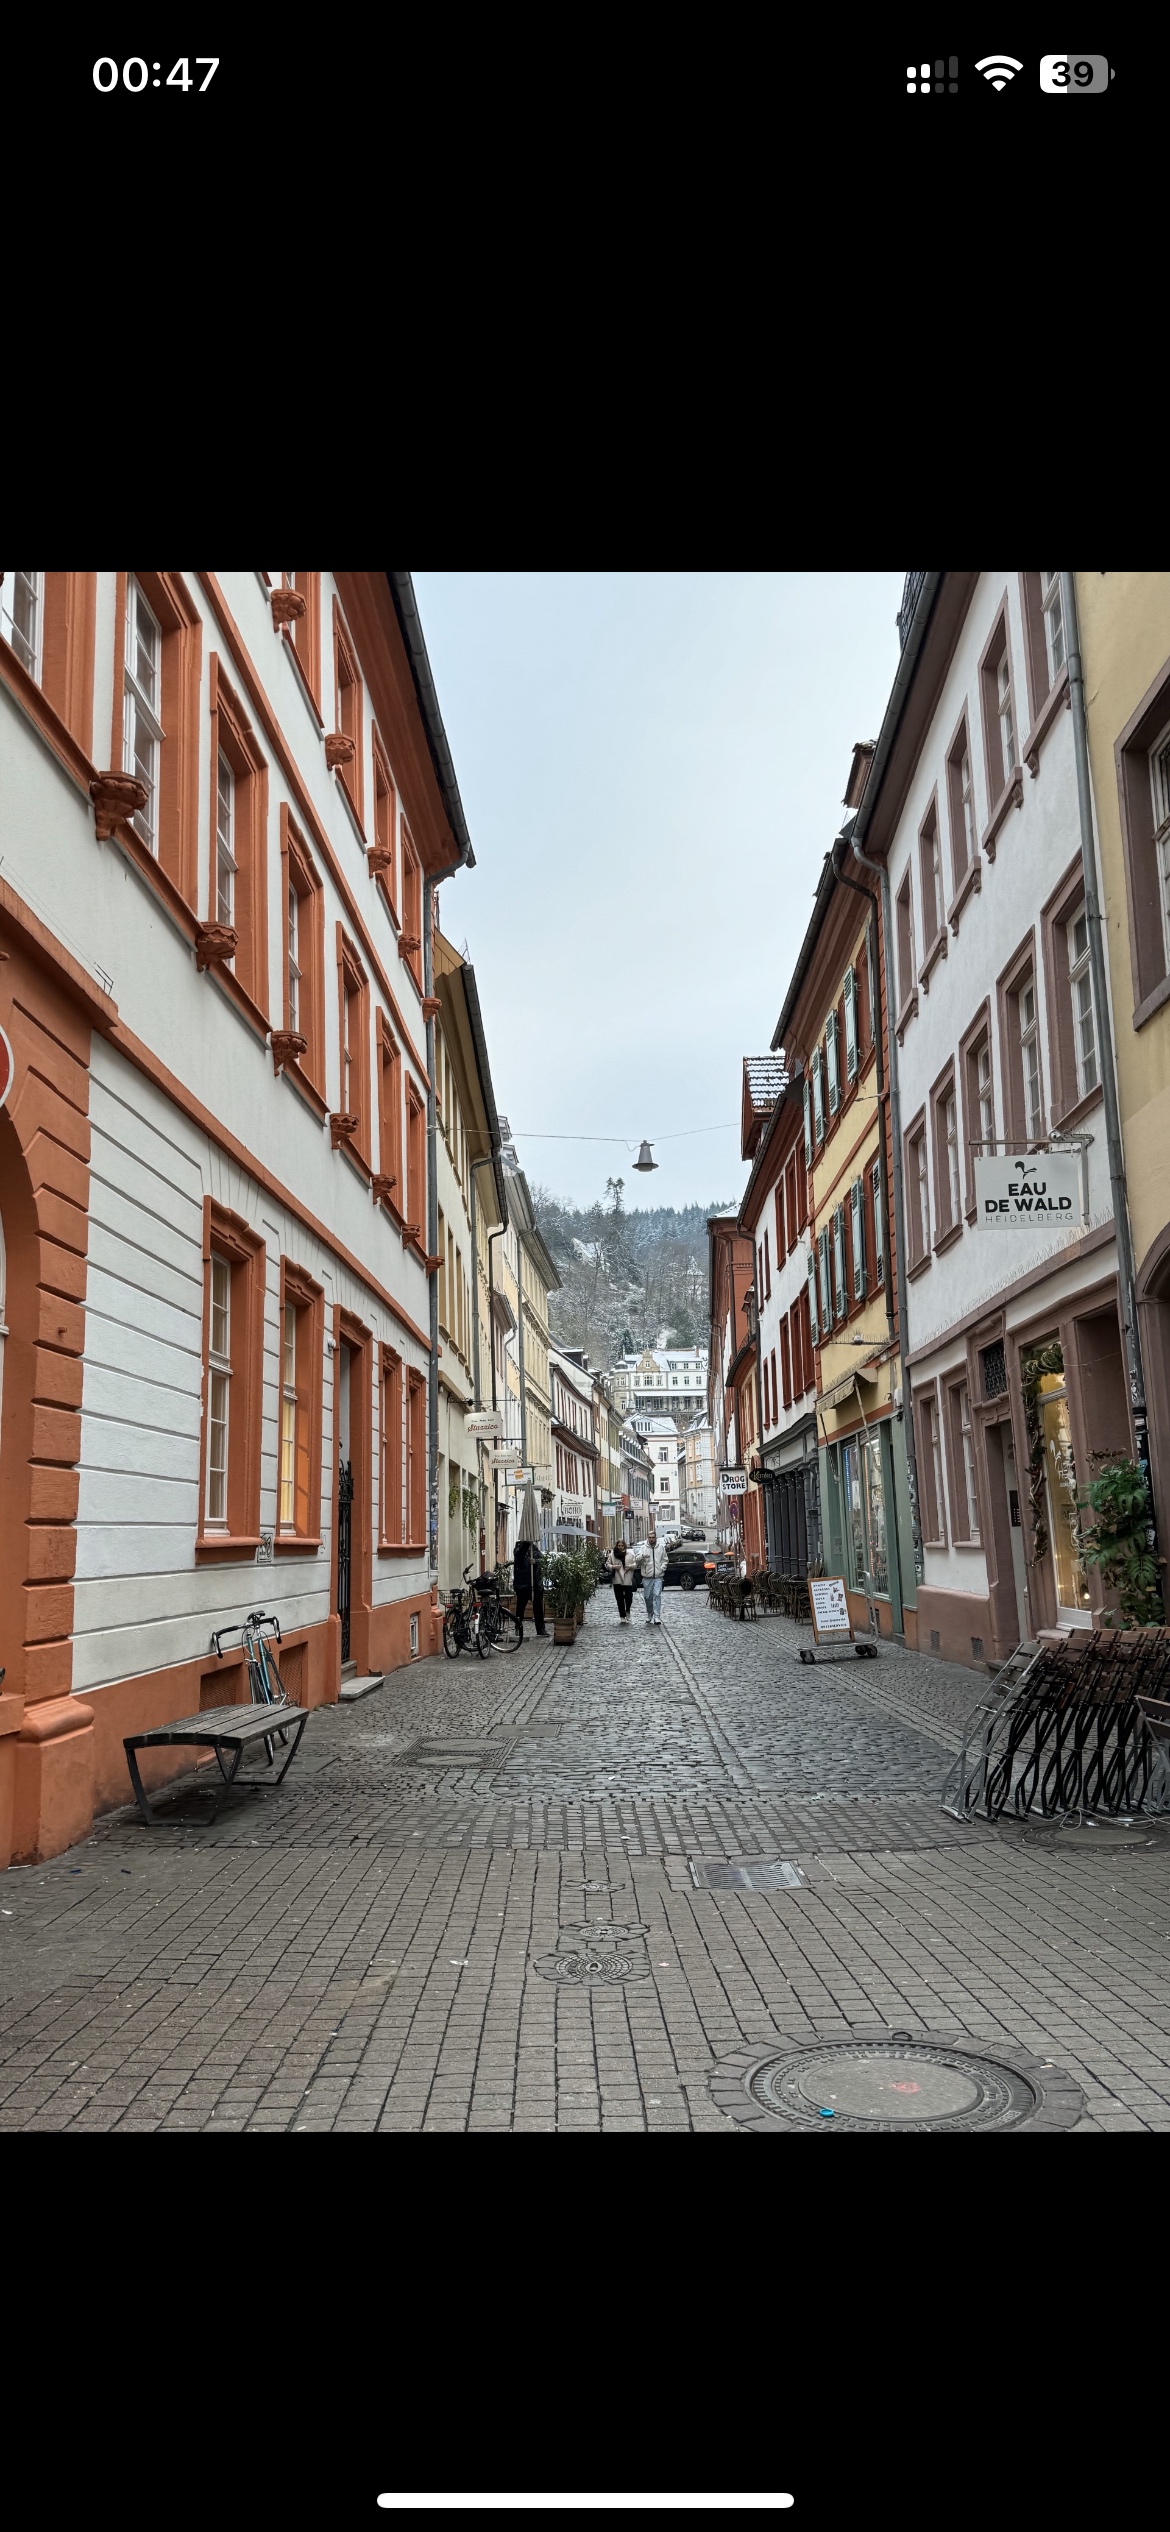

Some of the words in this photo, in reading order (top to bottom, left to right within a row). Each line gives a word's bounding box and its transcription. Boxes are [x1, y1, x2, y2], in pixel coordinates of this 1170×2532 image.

[1008, 1182, 1047, 1197] EAU
[985, 1199, 1010, 1213] DE
[1014, 1197, 1072, 1212] WALD
[985, 1213, 1074, 1223] HEIDELBERG
